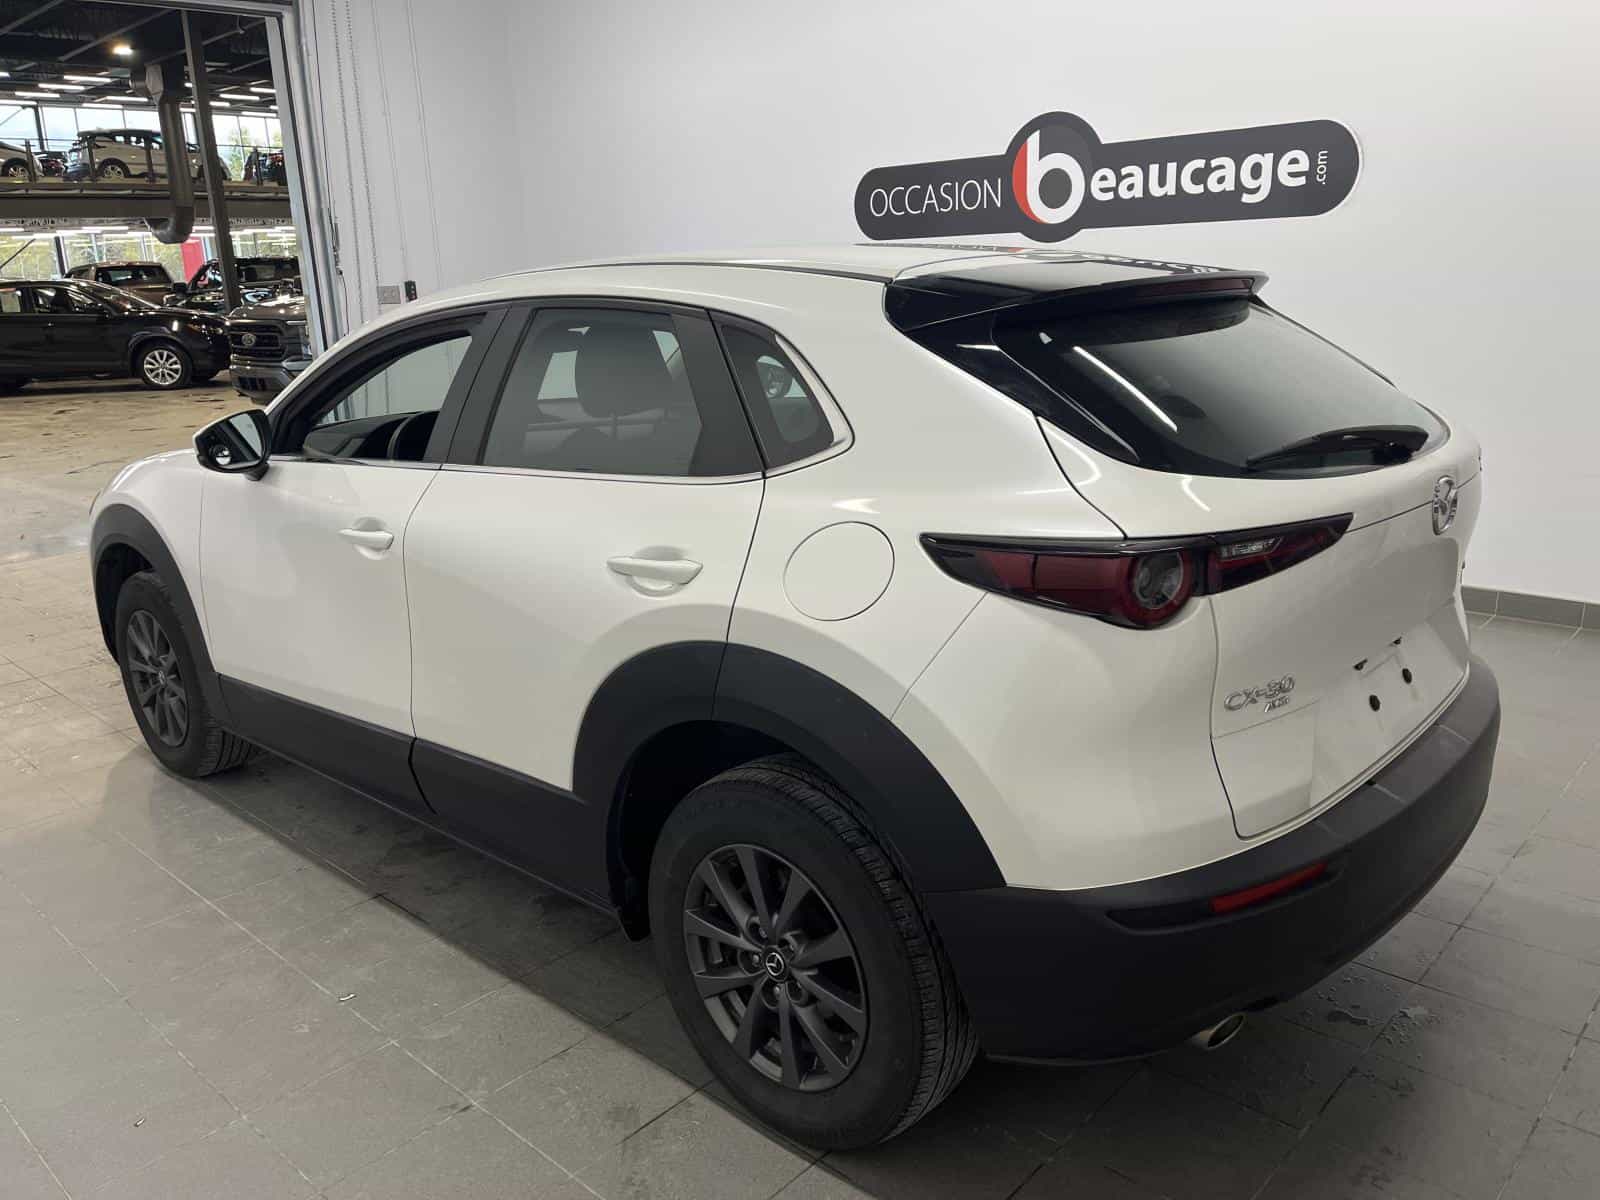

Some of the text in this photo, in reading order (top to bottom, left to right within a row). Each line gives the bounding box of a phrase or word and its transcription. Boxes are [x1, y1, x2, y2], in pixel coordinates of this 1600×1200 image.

[870, 128, 1329, 225] OCCASION beaucage .com
